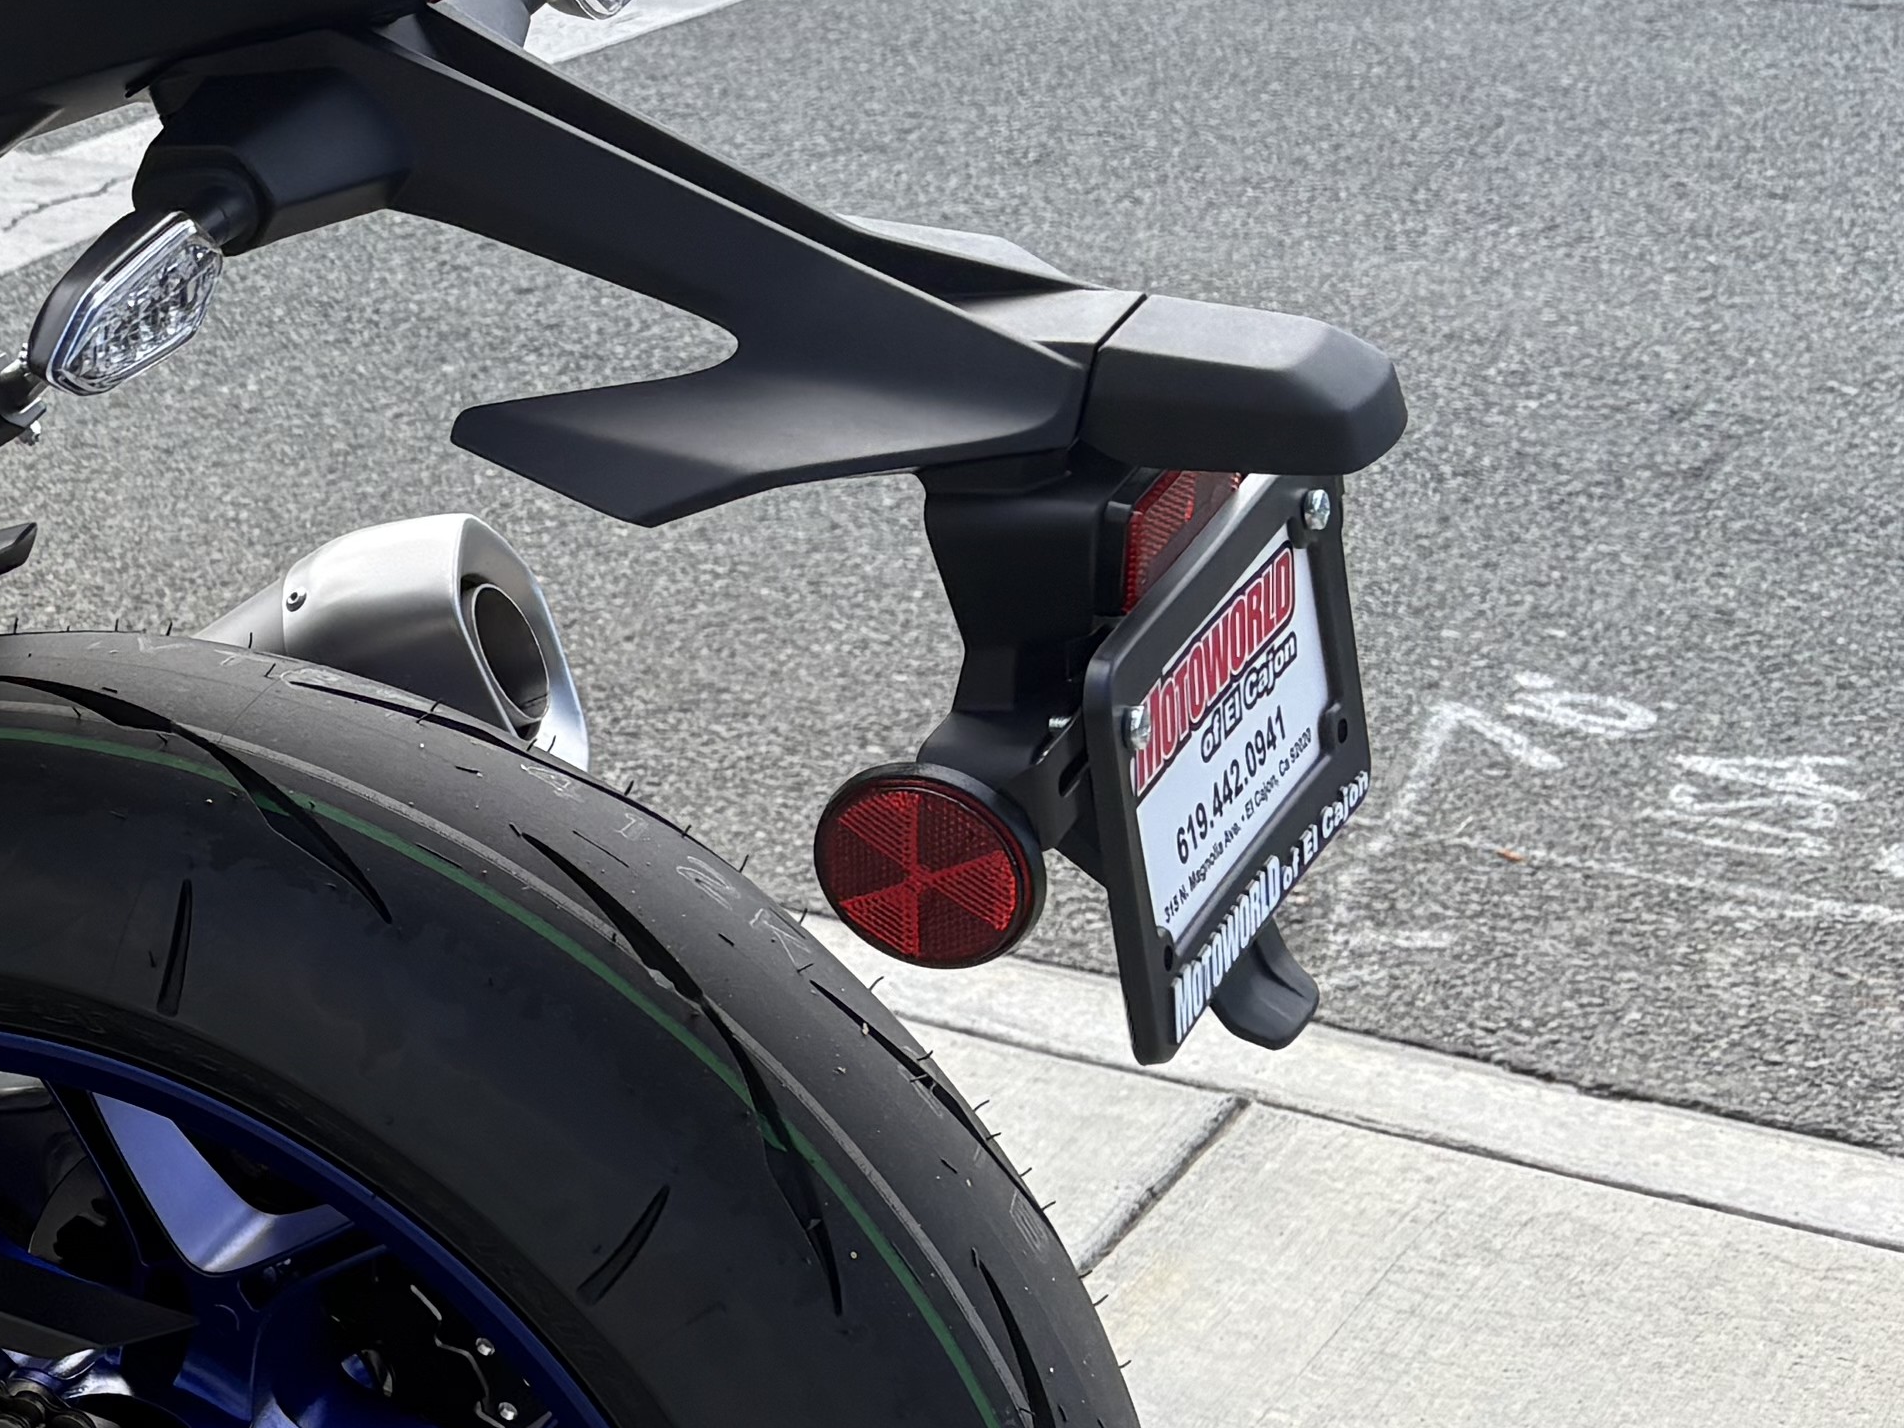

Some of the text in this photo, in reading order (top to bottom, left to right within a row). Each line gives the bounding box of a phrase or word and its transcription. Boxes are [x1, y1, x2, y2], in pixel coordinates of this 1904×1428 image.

[1135, 546, 1294, 797] MOTOWORLD
[1201, 632, 1297, 763] of El Cajon
[1164, 894, 1180, 924] 315
[1190, 840, 1224, 892] Magnolia
[1278, 759, 1290, 777] Ca
[1176, 705, 1286, 865] 619.442.0941
[1173, 771, 1370, 1045] MOTOWORLD of El Cajon
